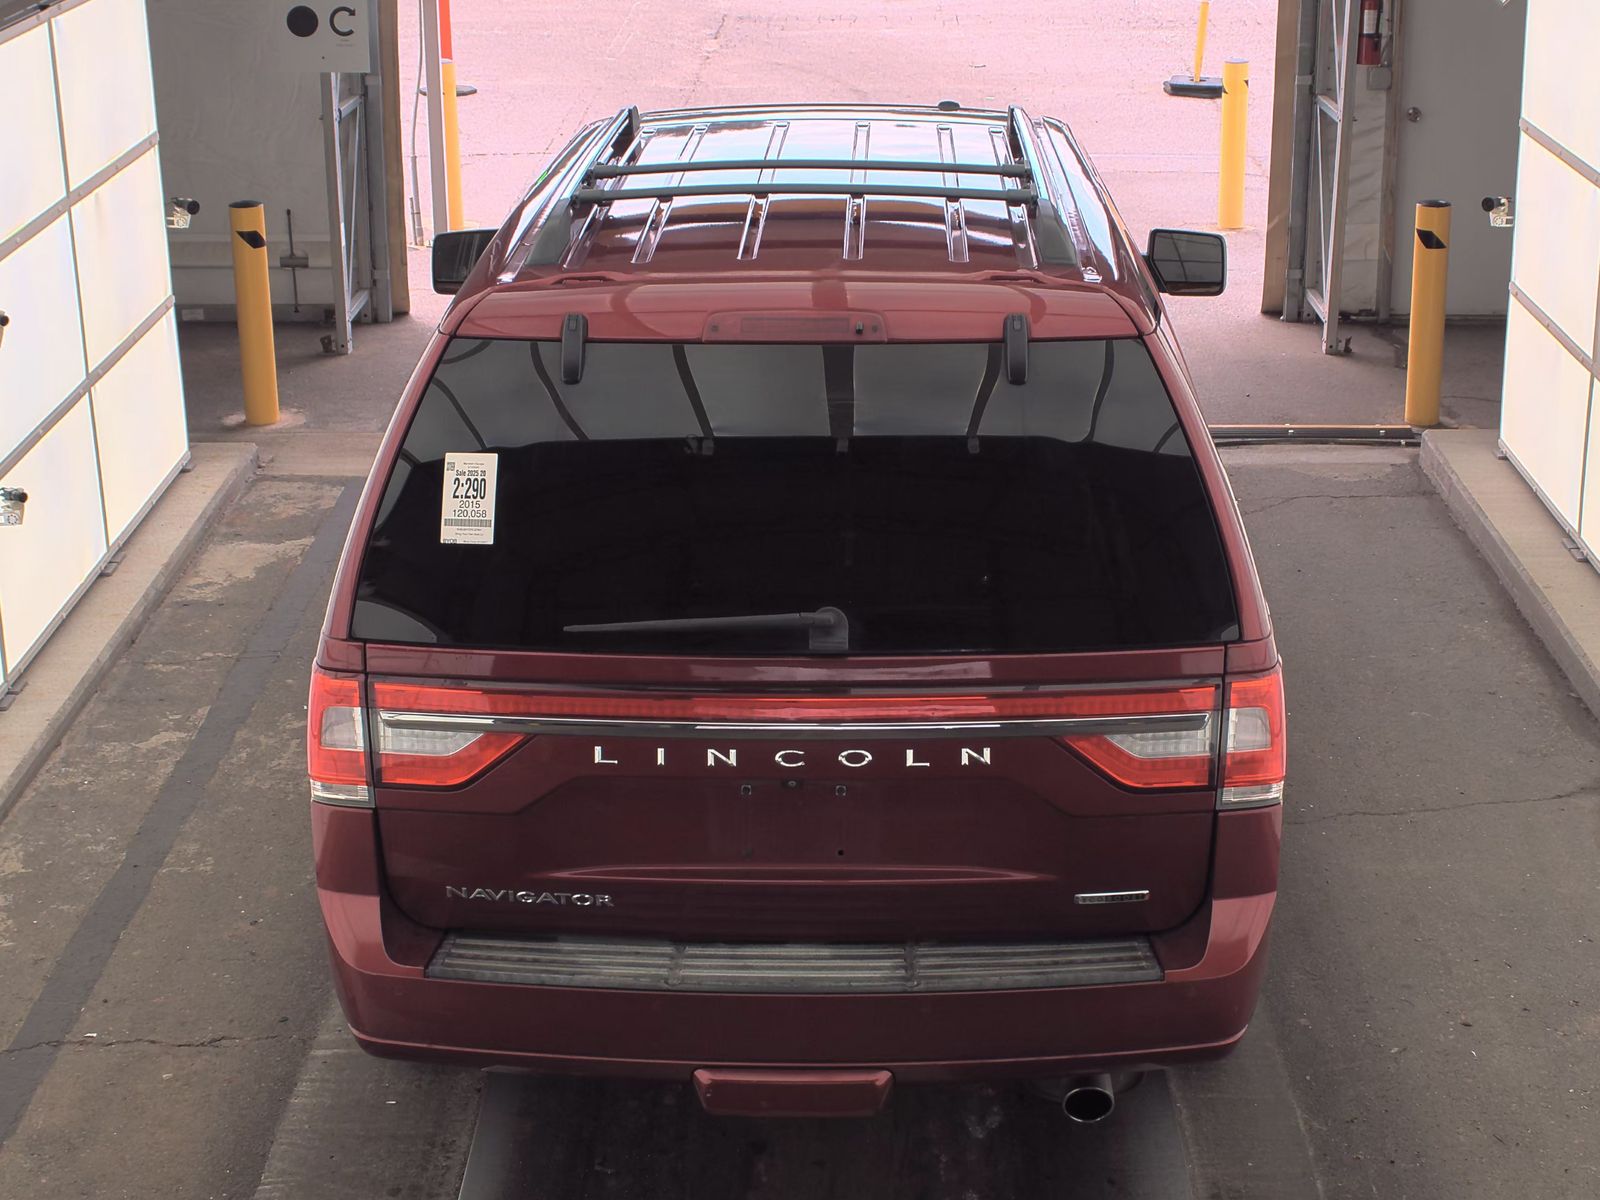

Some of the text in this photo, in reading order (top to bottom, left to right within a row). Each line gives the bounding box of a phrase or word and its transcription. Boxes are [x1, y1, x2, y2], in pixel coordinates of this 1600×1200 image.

[453, 477, 486, 499] 2:290
[453, 509, 487, 518] 120,058
[459, 500, 481, 509] 2015
[594, 745, 991, 768] LINCOLN
[446, 885, 615, 907] NAVIGATOR
